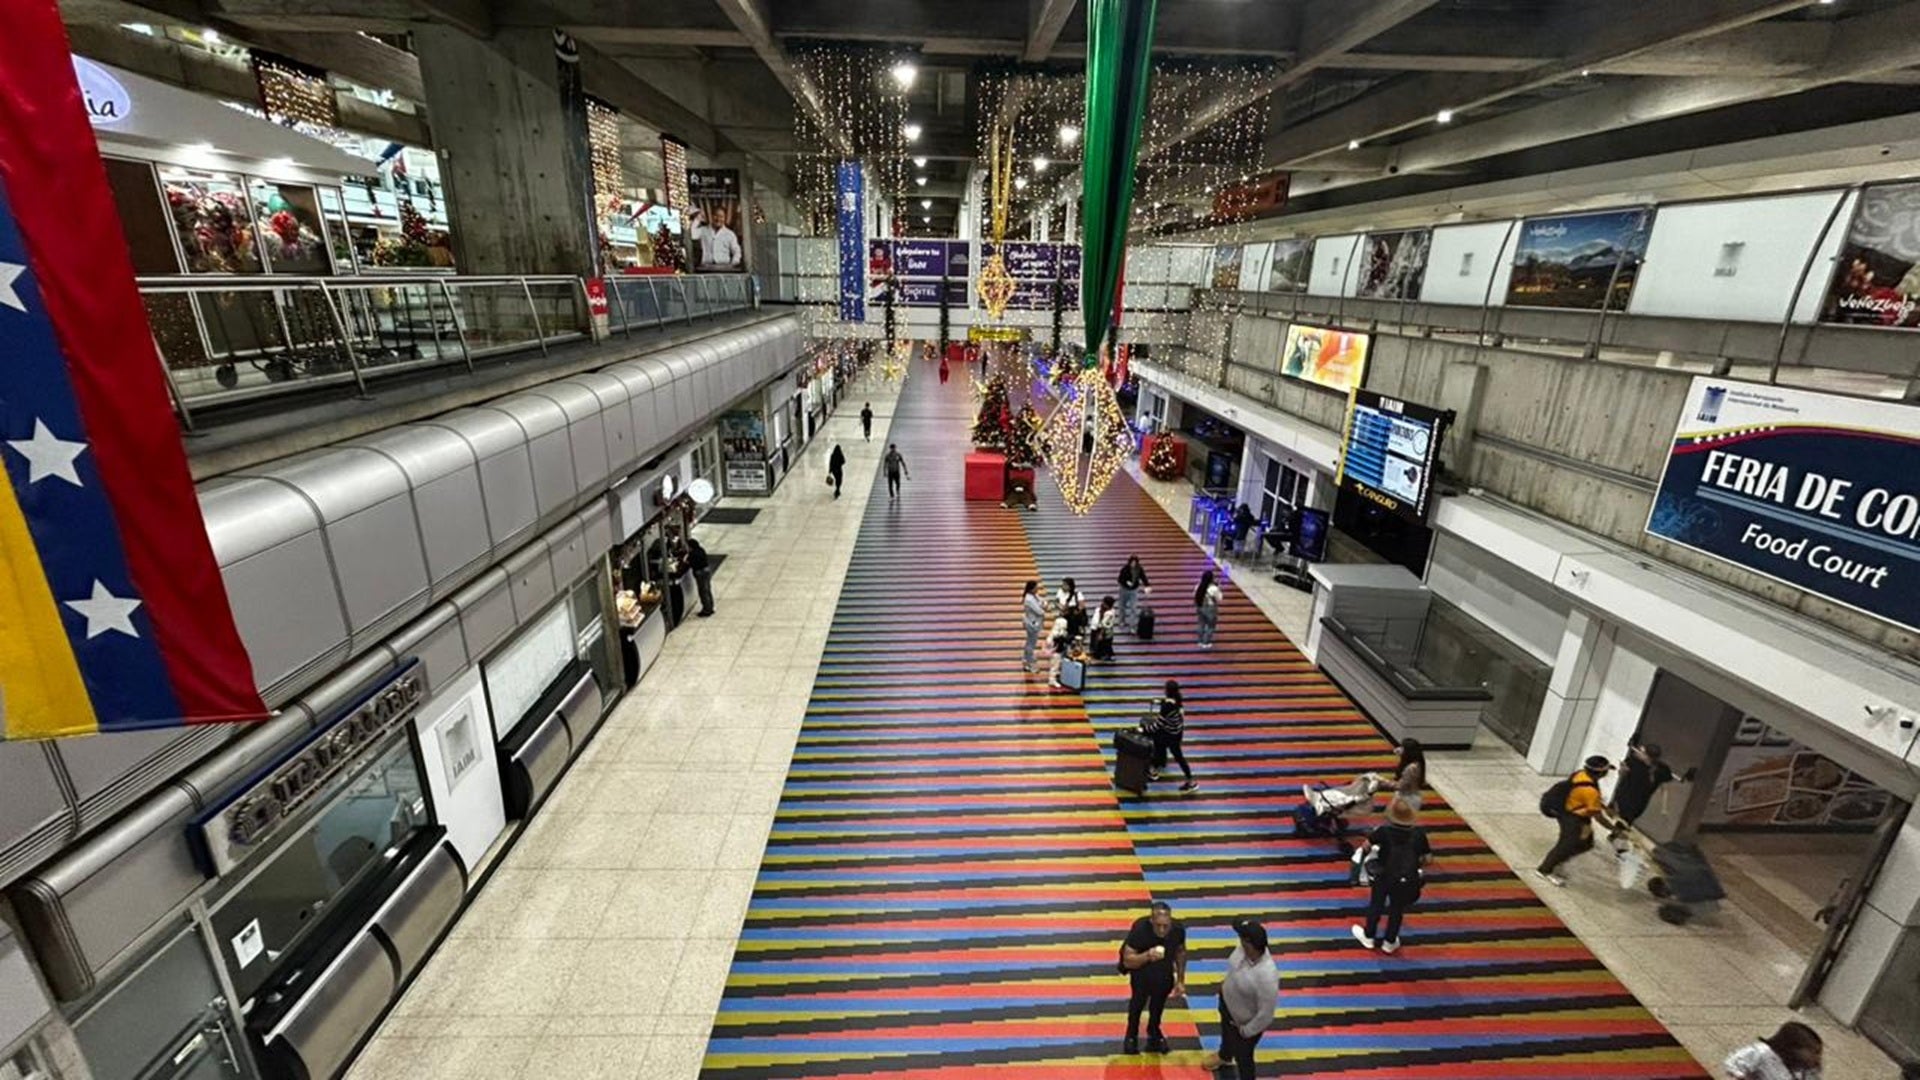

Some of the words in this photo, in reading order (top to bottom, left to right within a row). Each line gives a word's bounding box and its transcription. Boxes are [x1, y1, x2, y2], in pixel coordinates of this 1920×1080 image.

[1701, 450, 1789, 503] FERIA
[1795, 472, 1852, 518] DE
[1741, 523, 1809, 561] Food
[1807, 545, 1889, 589] Court
[452, 748, 476, 779] IAIM
